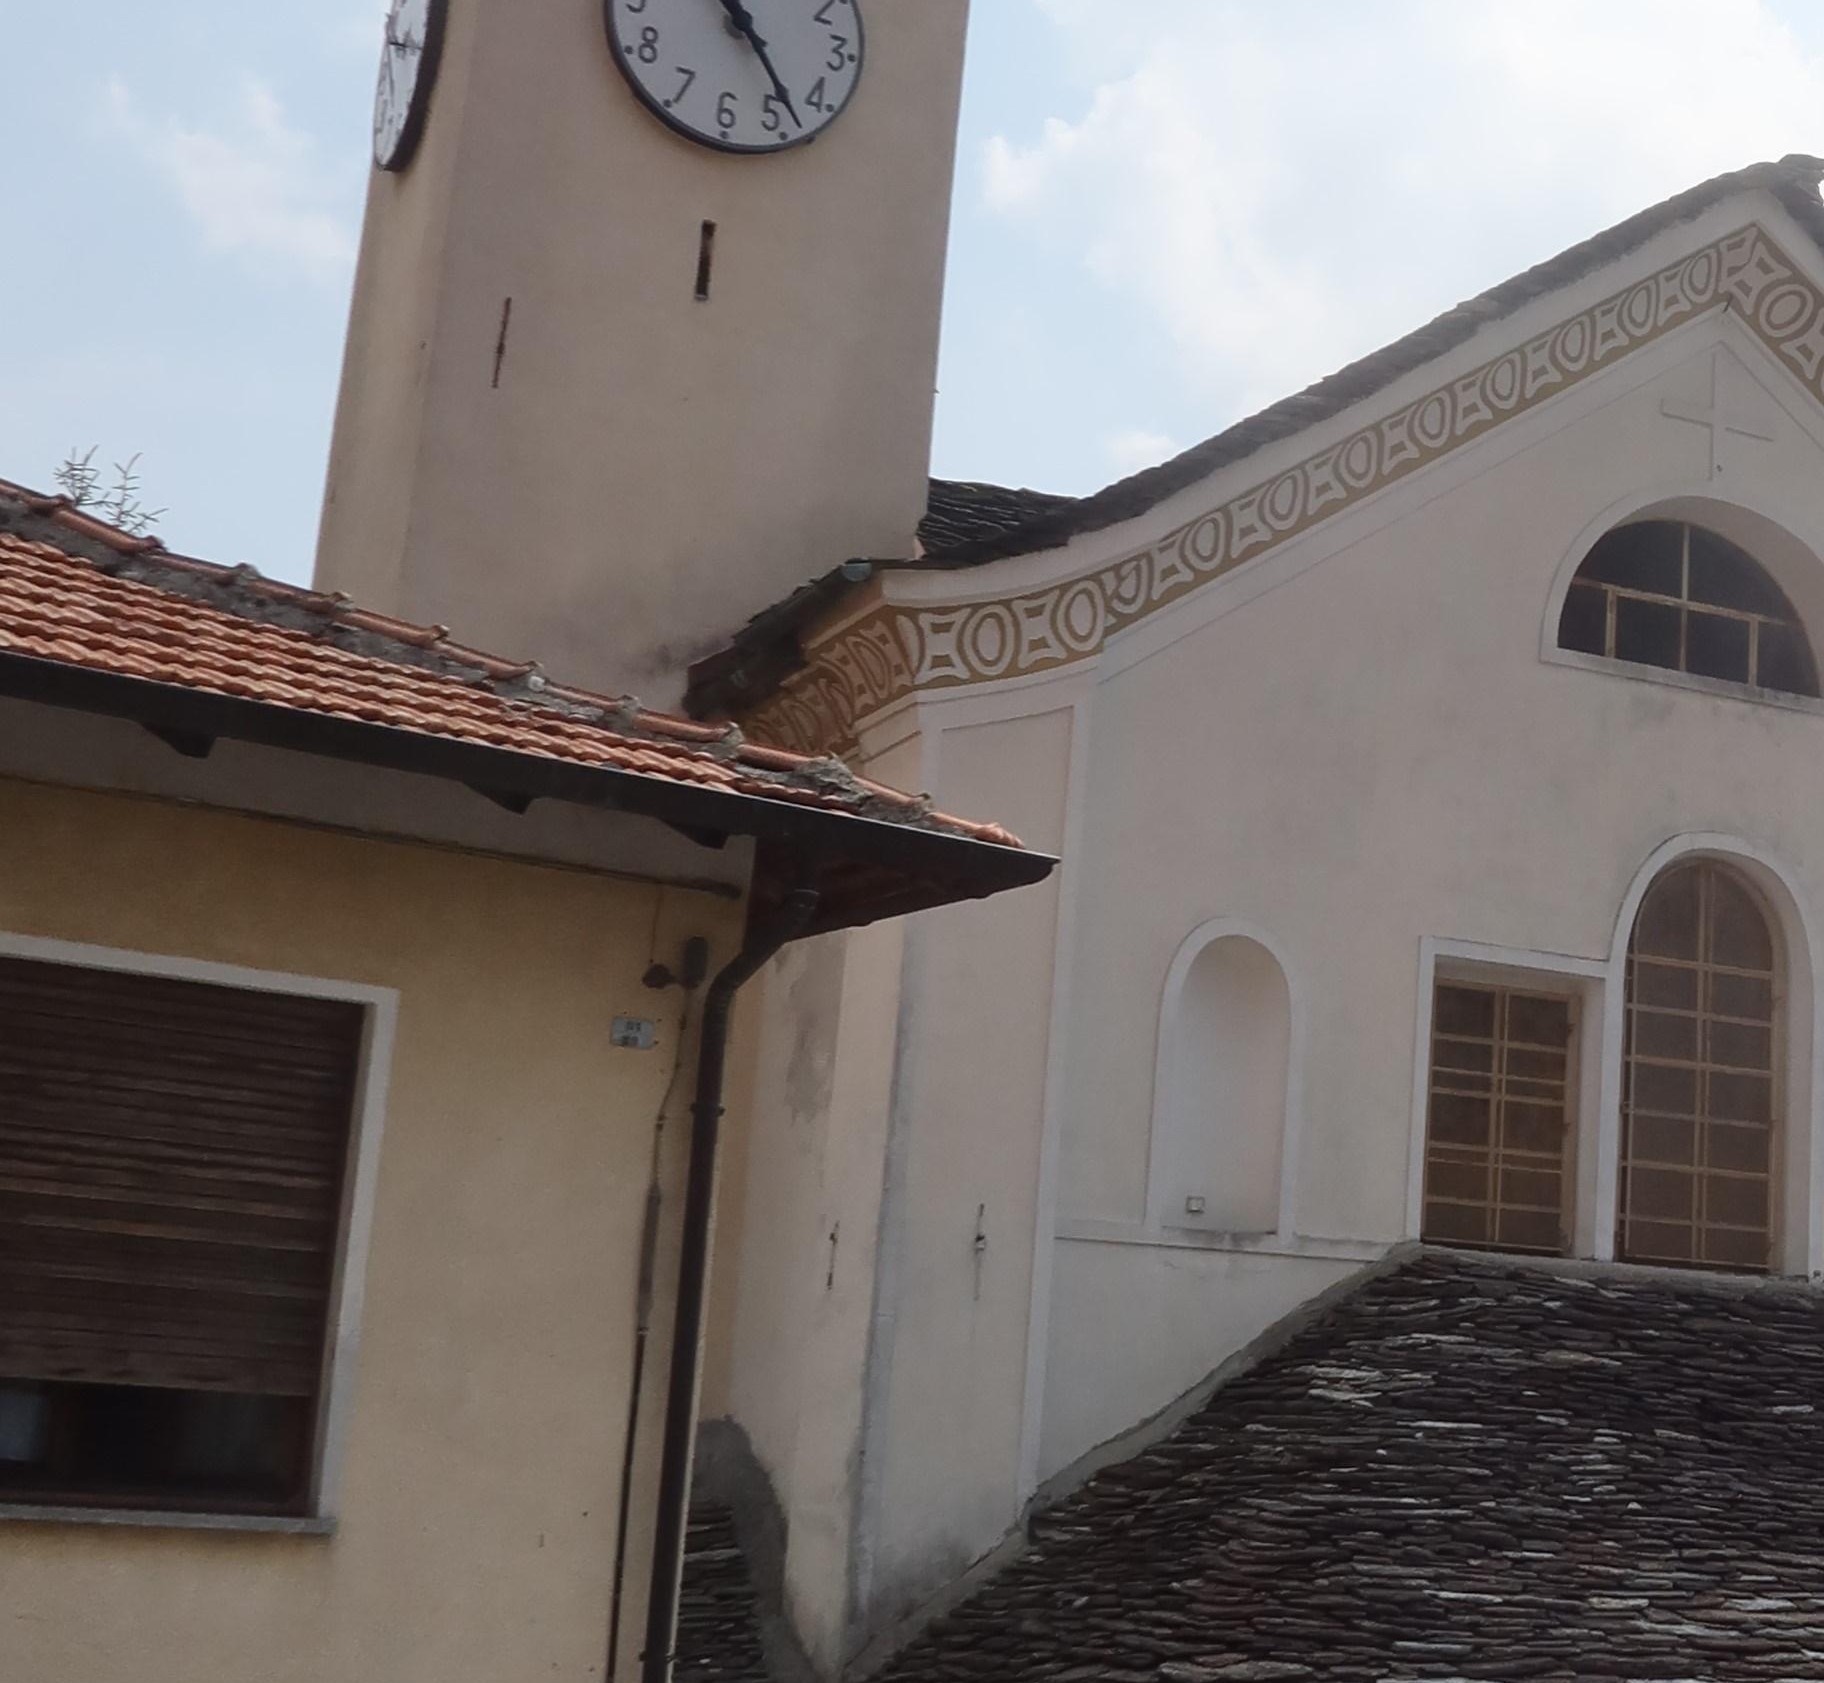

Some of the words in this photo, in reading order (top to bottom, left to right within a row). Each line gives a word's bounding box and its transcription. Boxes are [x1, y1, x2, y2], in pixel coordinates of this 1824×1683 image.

[637, 25, 660, 64] 8
[825, 34, 849, 72] 3
[673, 66, 697, 104] 7
[804, 75, 827, 114] 4
[715, 91, 739, 130] 6
[760, 94, 783, 132] 5
